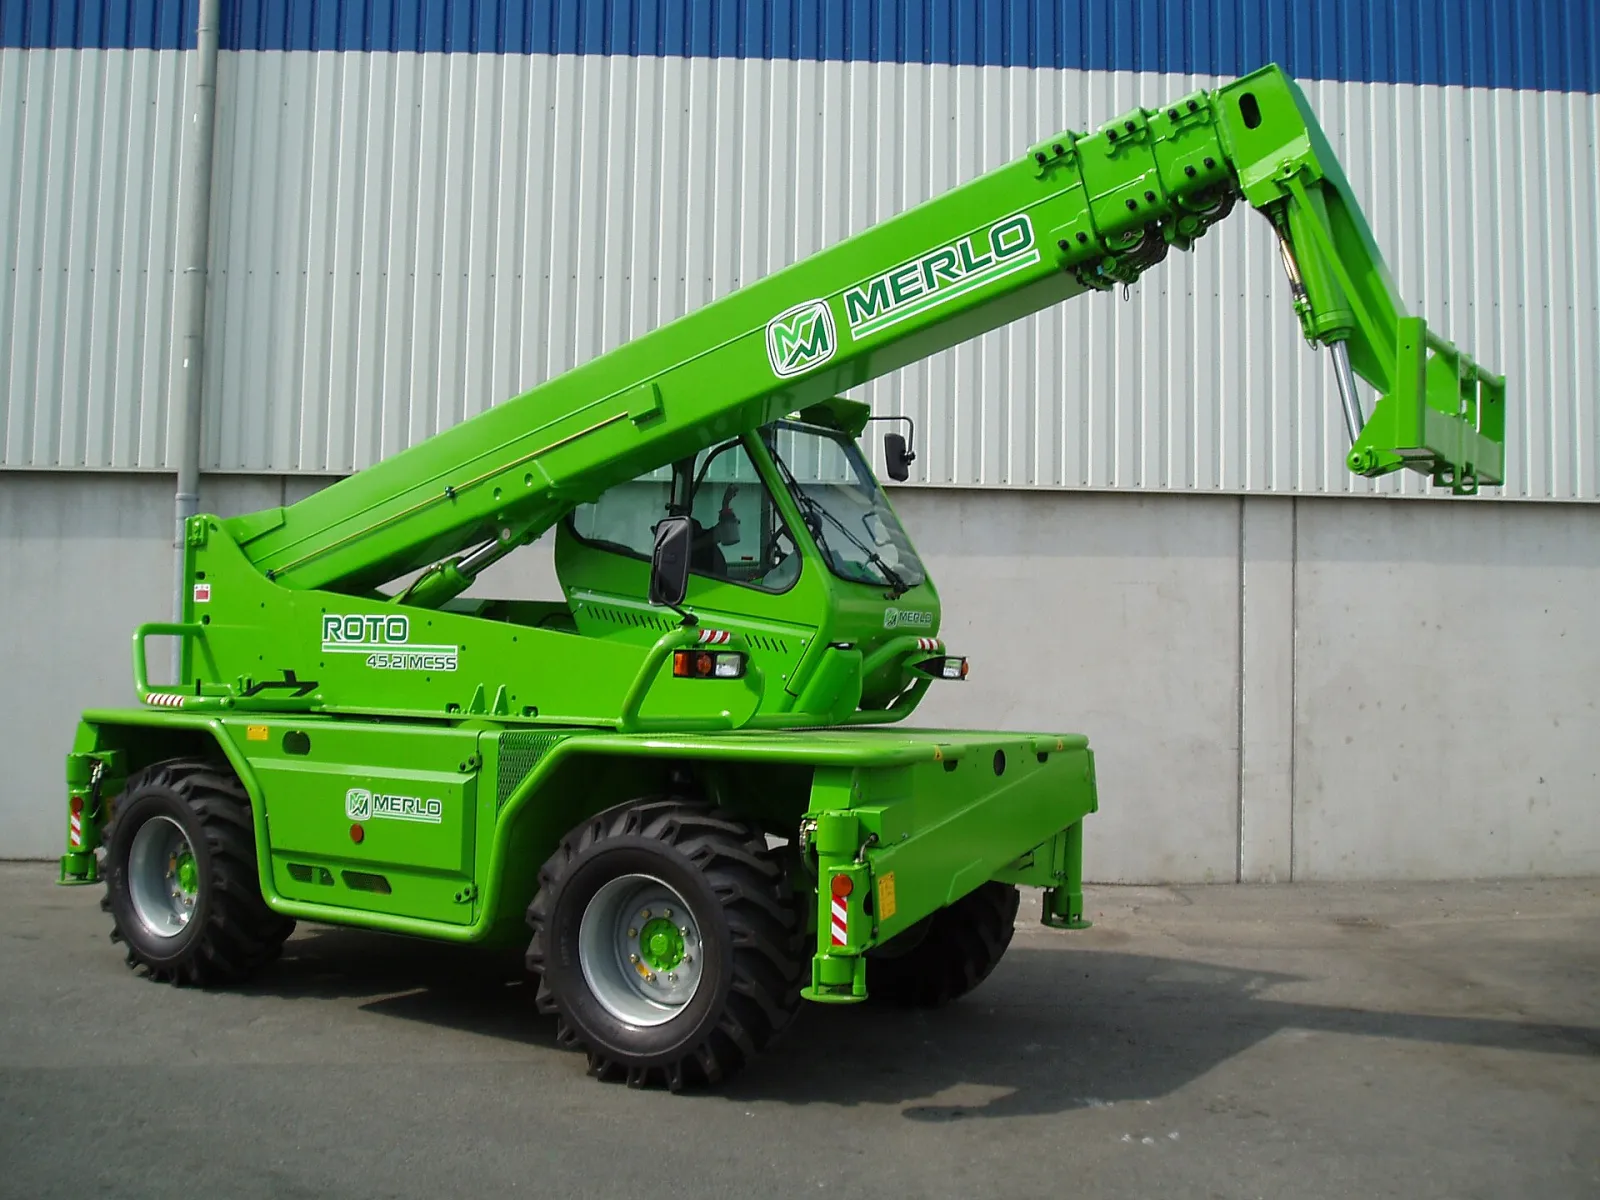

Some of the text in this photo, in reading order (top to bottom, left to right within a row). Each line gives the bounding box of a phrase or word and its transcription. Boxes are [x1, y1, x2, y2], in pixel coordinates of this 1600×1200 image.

[845, 215, 1034, 326] MERLO
[323, 615, 408, 642] ROTO
[367, 655, 457, 671] 45.21 MCSS
[373, 795, 441, 816] MERLO
